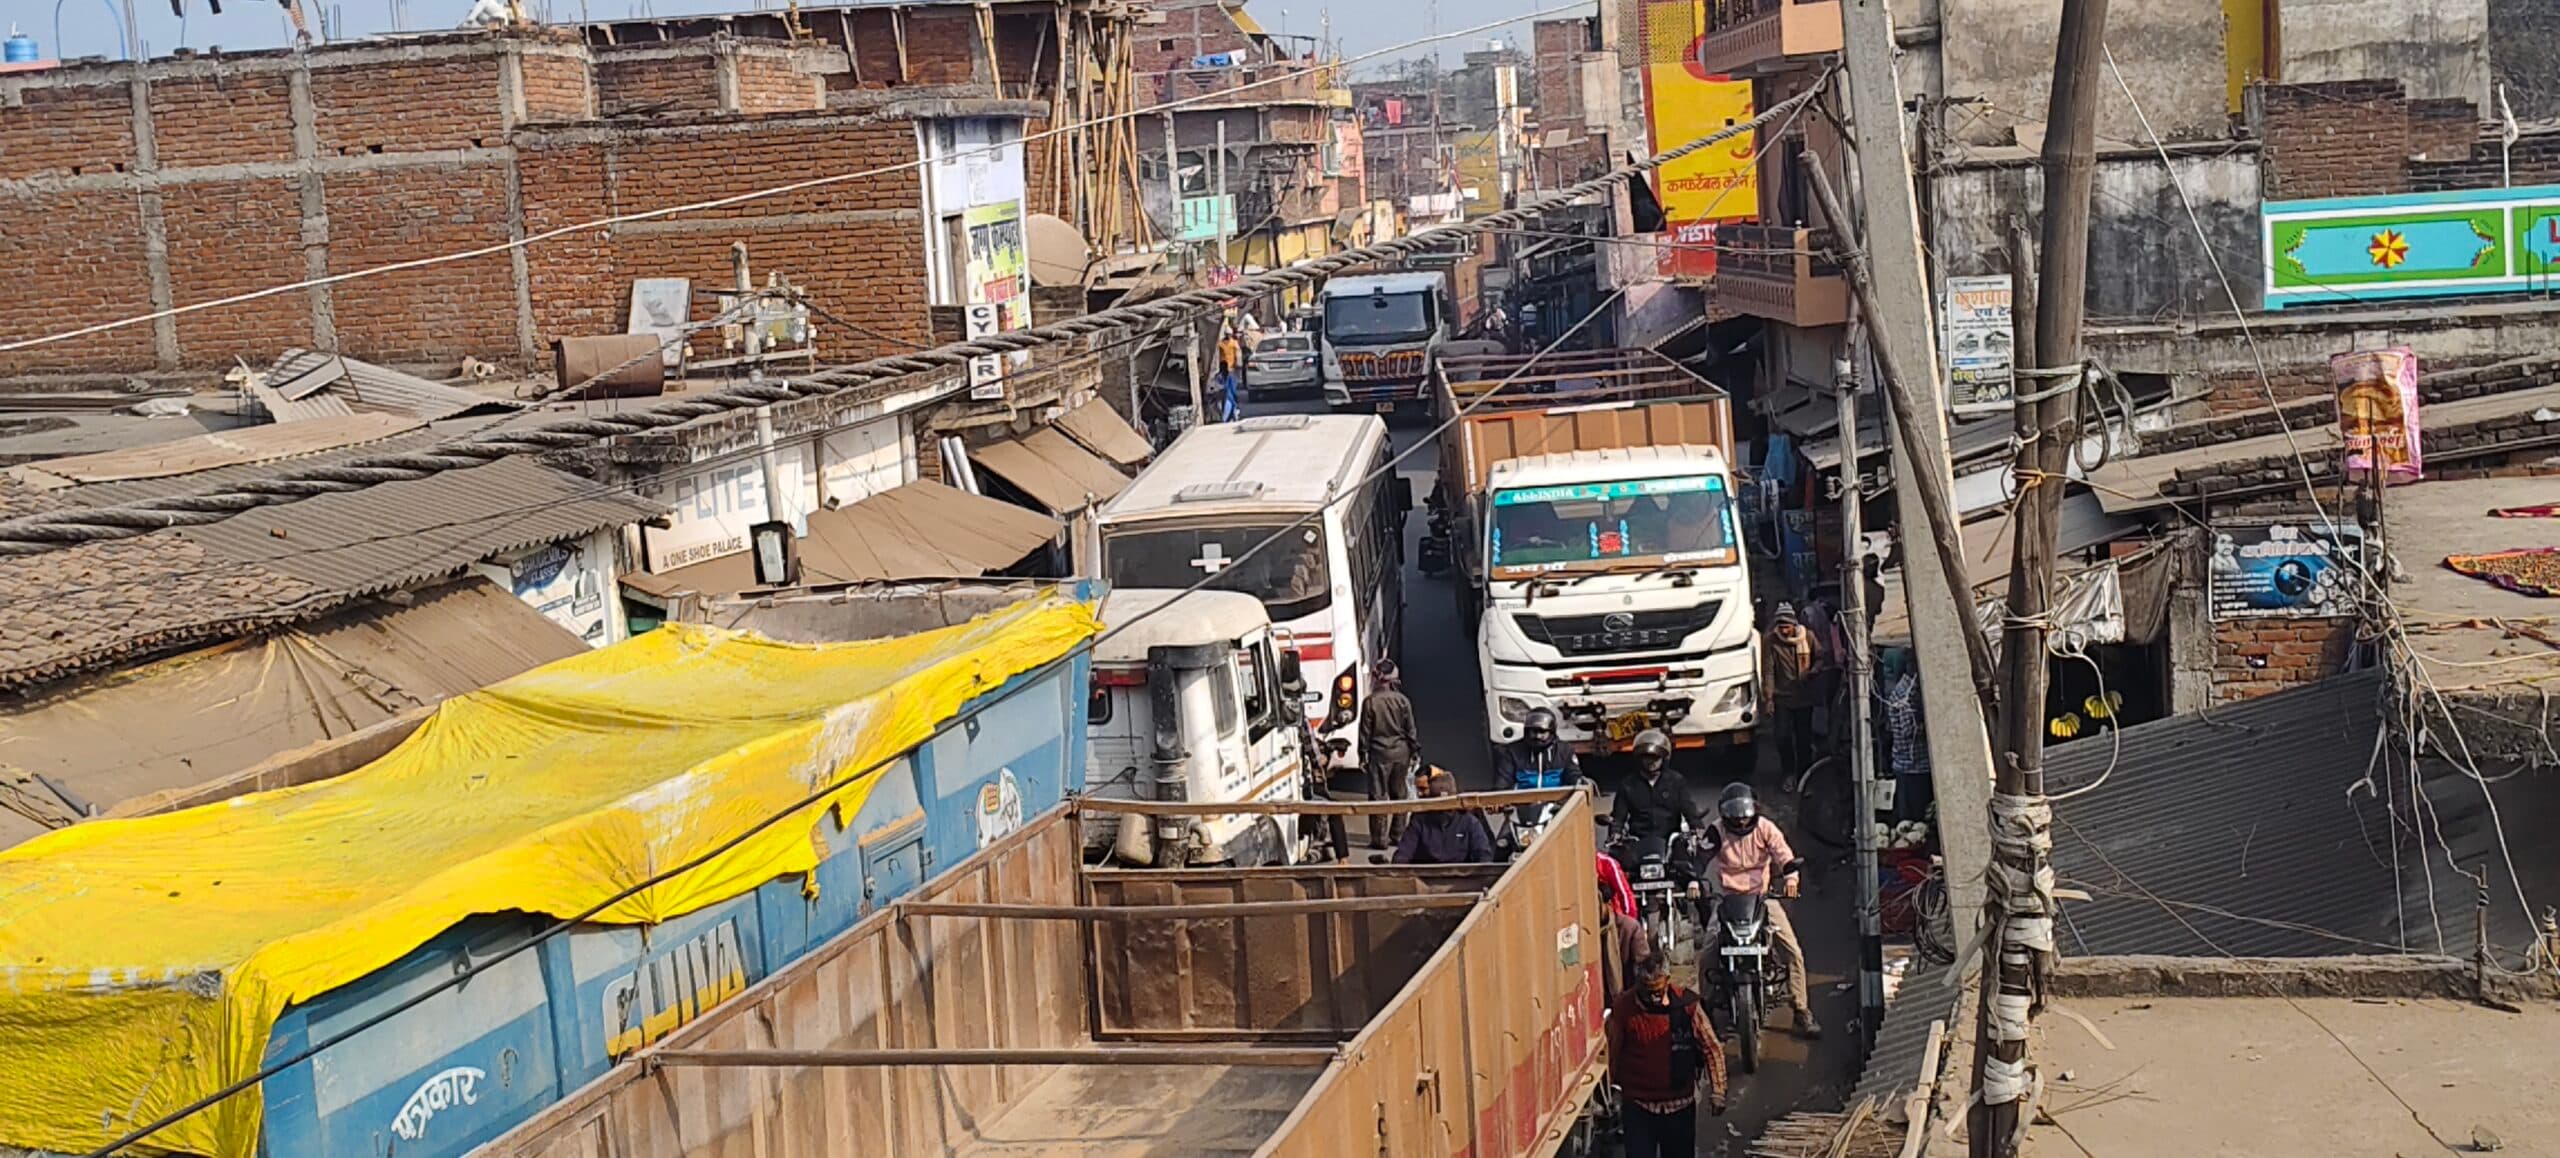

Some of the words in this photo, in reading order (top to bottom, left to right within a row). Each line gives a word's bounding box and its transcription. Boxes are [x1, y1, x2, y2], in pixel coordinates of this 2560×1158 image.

[972, 306, 997, 377] CYER
[662, 555, 670, 569] A
[670, 550, 688, 567] ONE
[688, 543, 711, 562] SHOE
[712, 536, 743, 556] PALACE
[391, 1066, 486, 1140] पत्रकार
